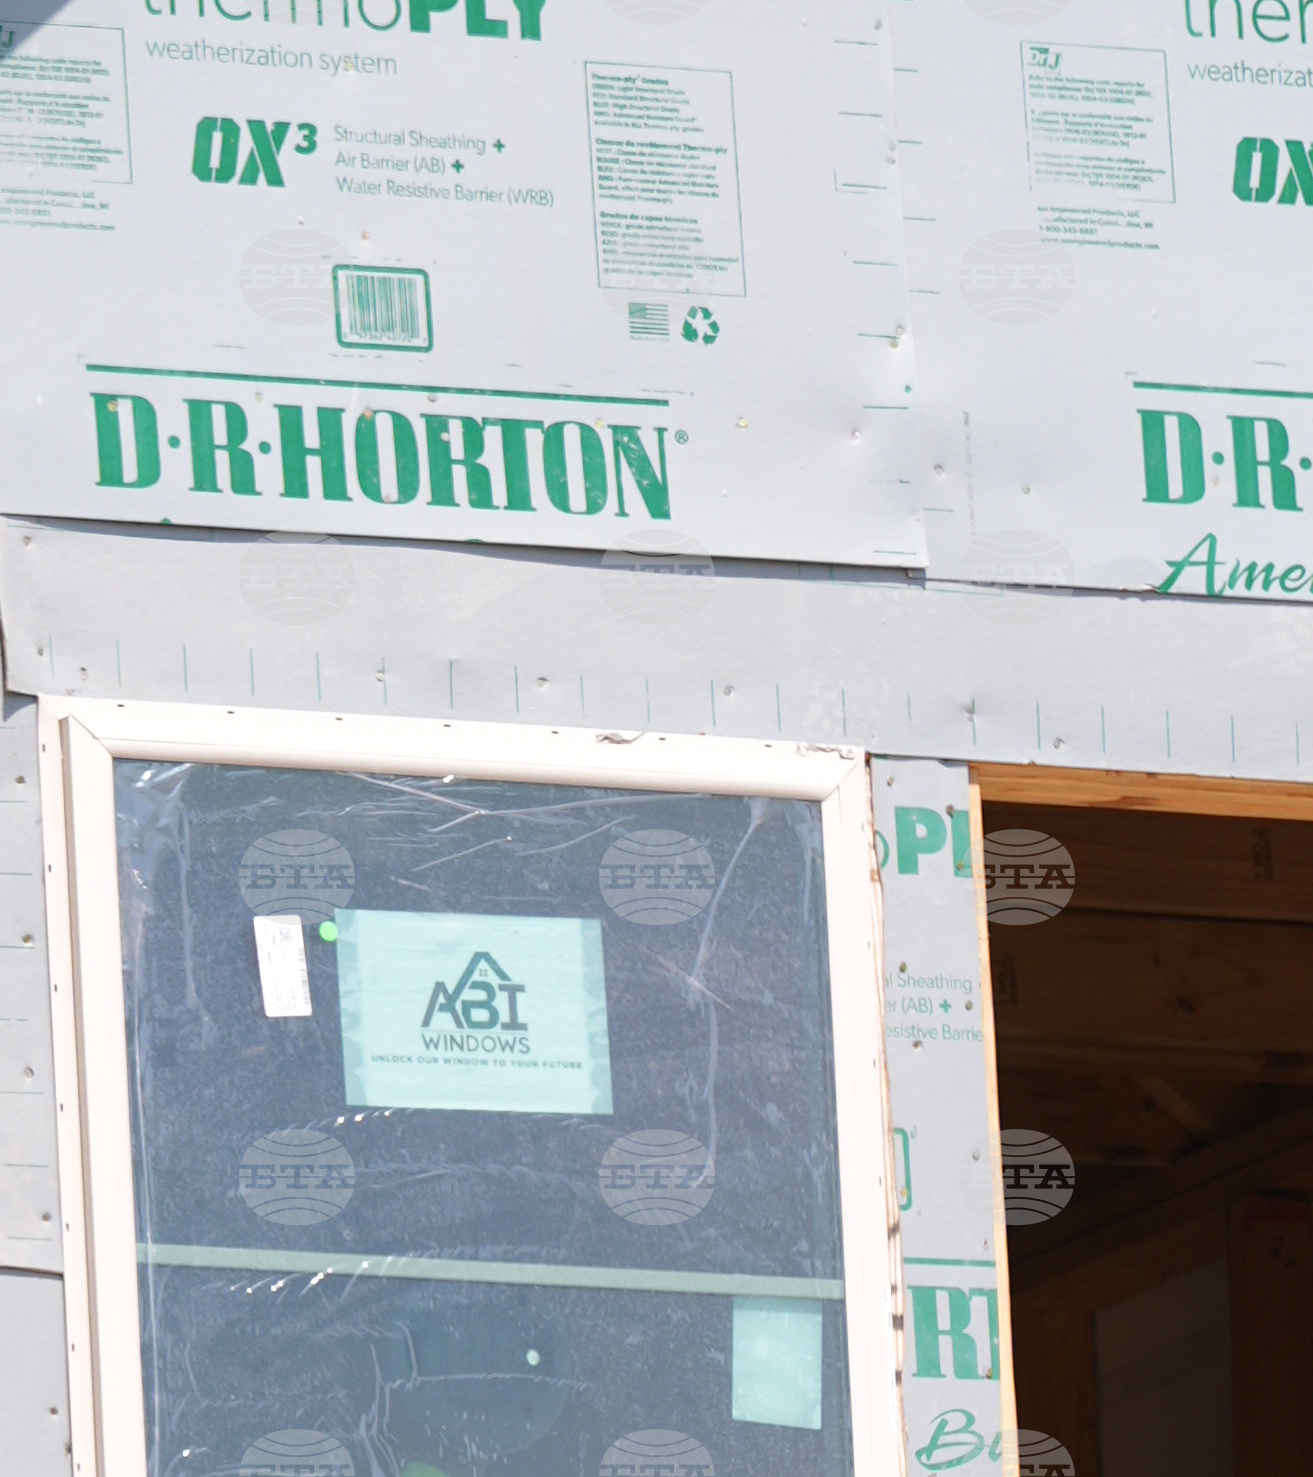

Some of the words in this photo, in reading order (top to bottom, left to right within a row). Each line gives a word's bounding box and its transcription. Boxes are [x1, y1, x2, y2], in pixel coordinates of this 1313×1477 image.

[145, 38, 313, 70] weatherization
[319, 52, 397, 76] system
[334, 124, 405, 145] Structural
[409, 130, 486, 155] Sheathing
[336, 152, 356, 167] Air
[361, 153, 409, 171] Barrier
[414, 155, 446, 175] (AB)
[337, 177, 382, 194] Water
[387, 180, 450, 199] Resistive
[455, 184, 503, 203] Barrier
[507, 188, 554, 208] (WRB)
[421, 952, 528, 1031] ABI
[898, 975, 973, 995] Sheathing
[421, 1033, 531, 1054] WINDOWS
[371, 1055, 413, 1063] UNLOCK
[510, 1060, 539, 1068] YOUR
[542, 1061, 582, 1069] FUTURE
